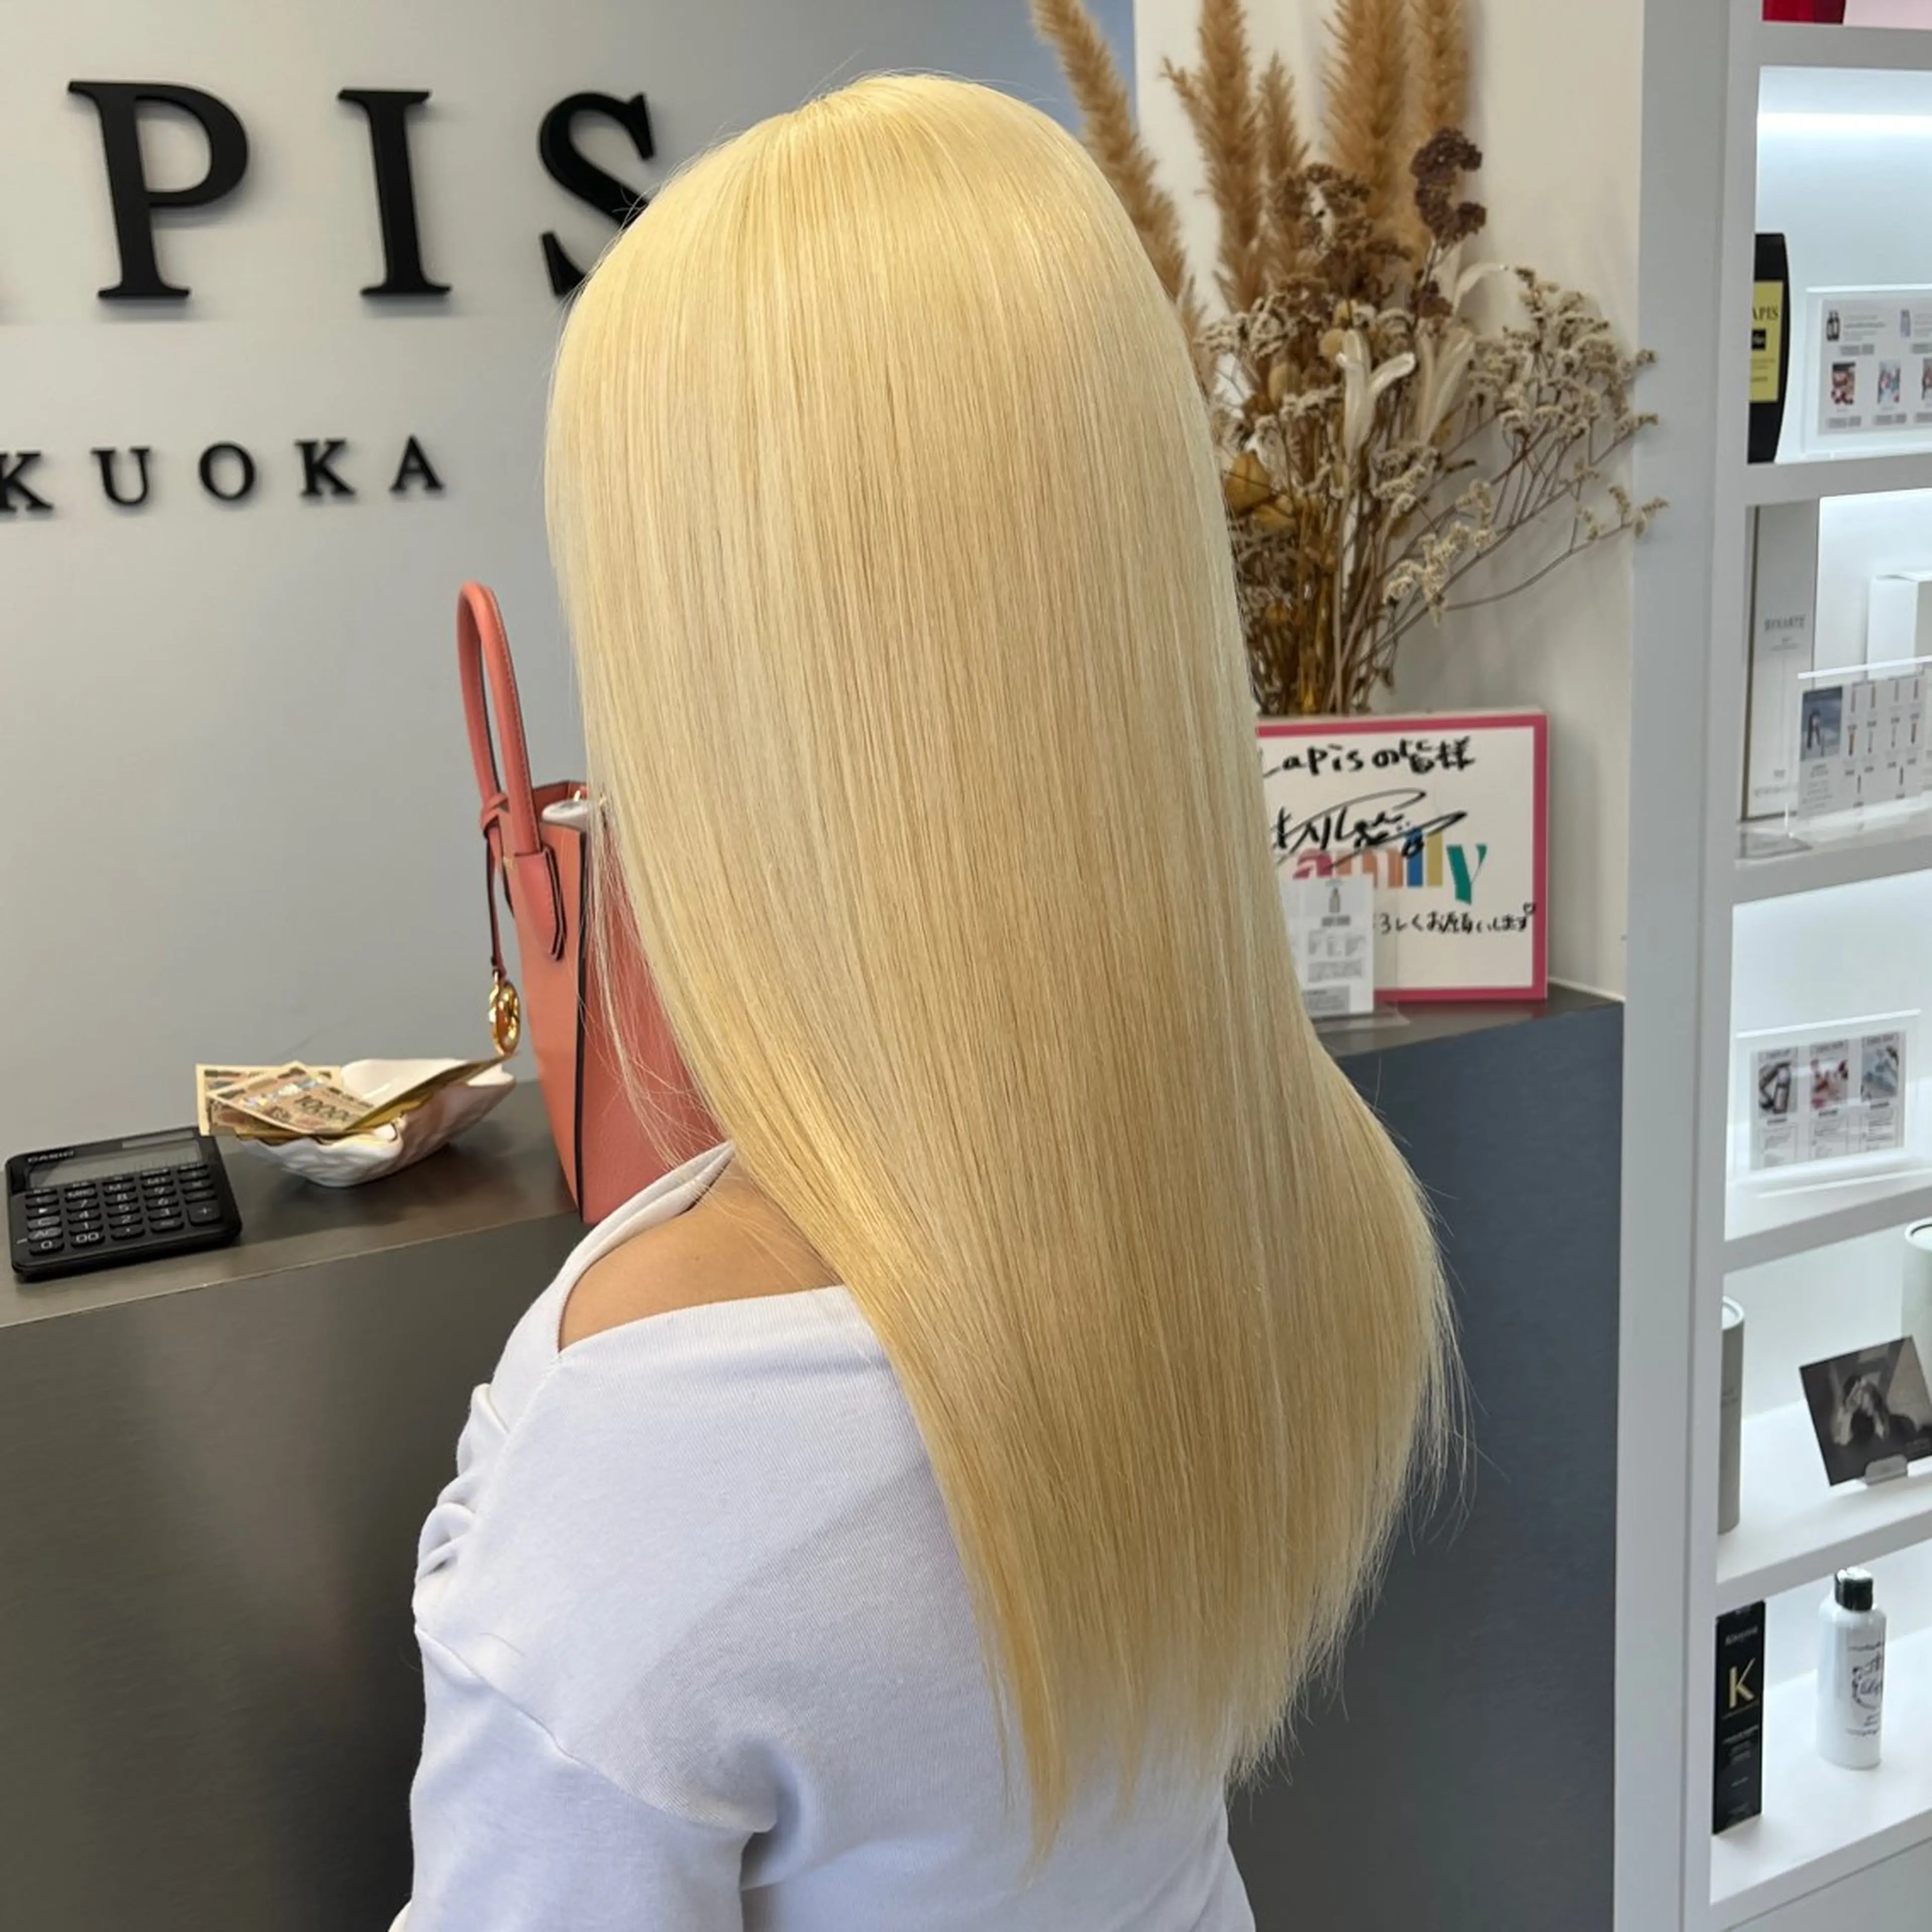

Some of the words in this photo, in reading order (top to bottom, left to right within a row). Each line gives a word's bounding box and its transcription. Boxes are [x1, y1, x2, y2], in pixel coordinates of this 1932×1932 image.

[41, 1240, 52, 1250] 0
[76, 1232, 99, 1244] 00
[1728, 1657, 1756, 1709] K
